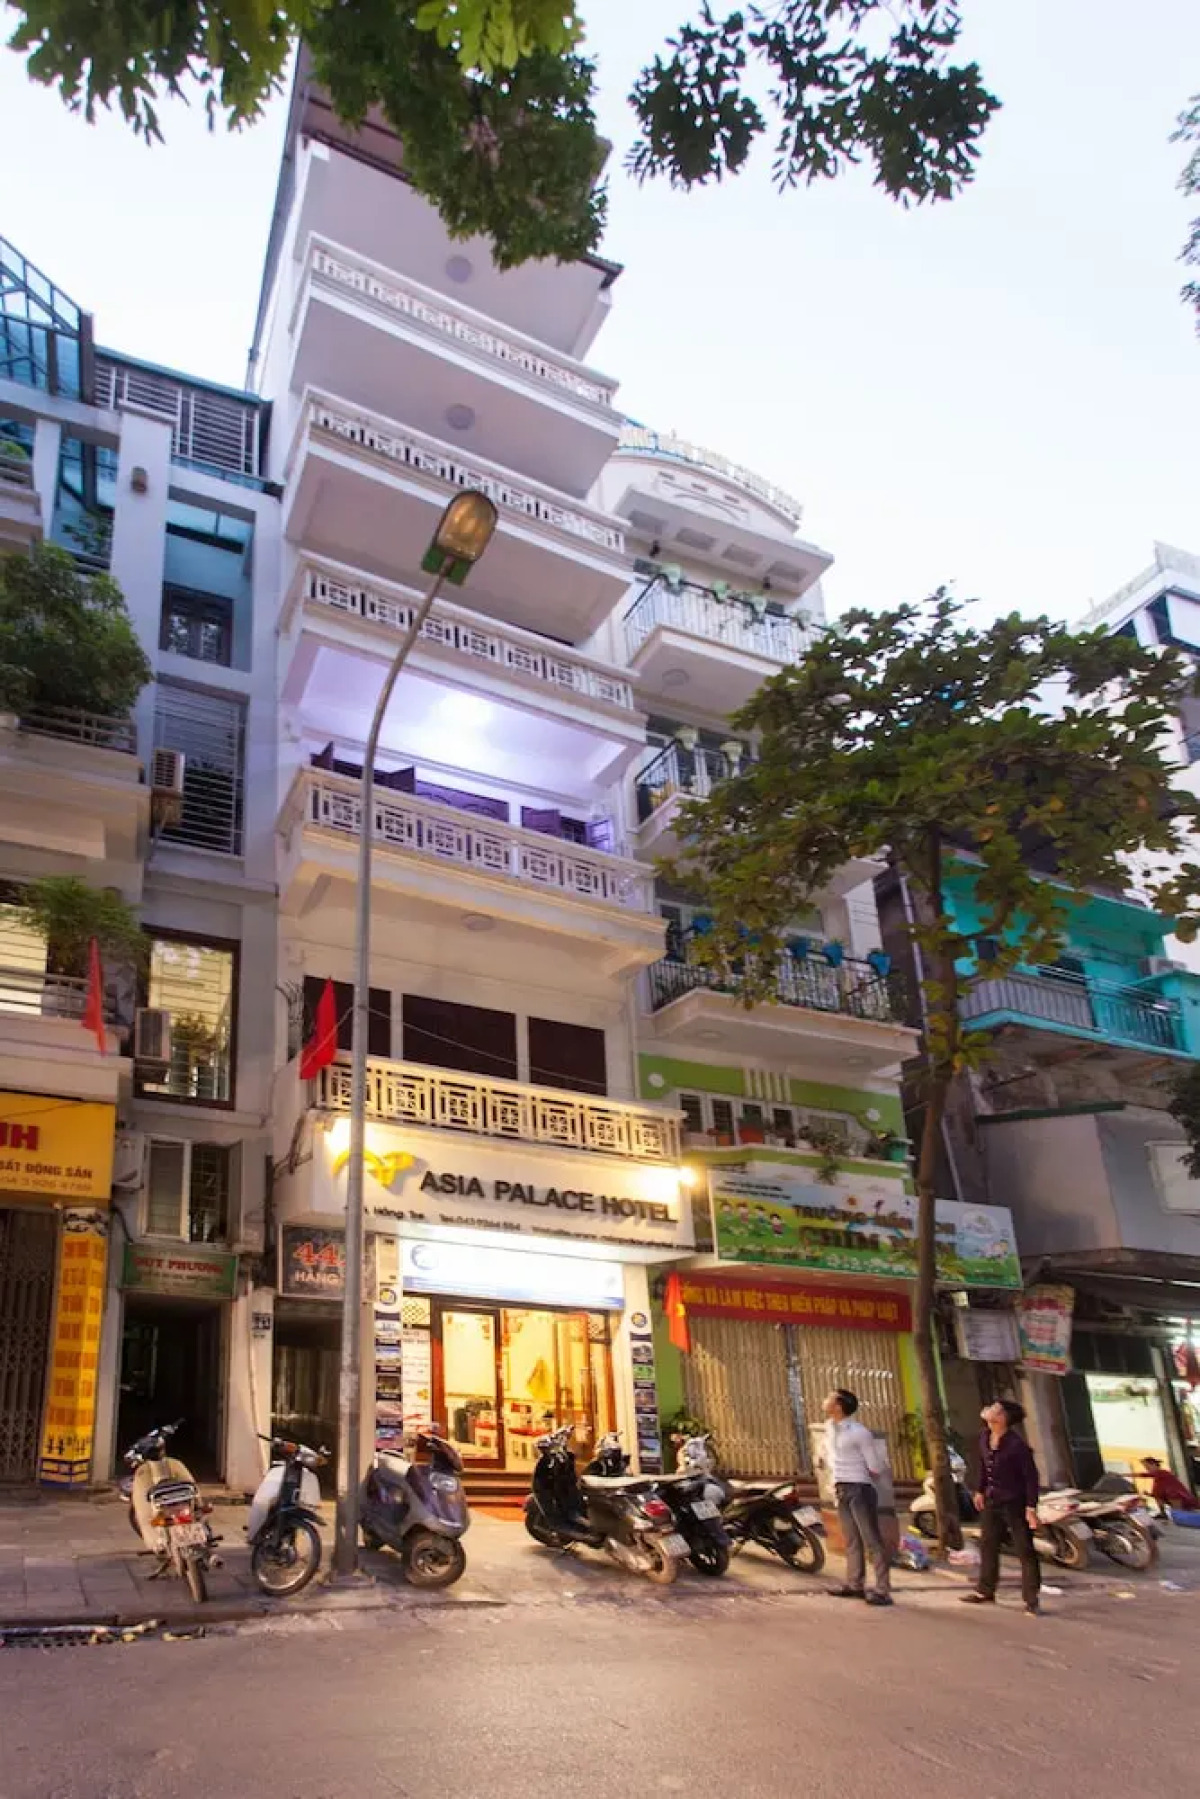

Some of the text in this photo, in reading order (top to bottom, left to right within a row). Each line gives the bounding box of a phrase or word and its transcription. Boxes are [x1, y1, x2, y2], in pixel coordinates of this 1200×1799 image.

[420, 1170, 678, 1224] ASIA PALACE HOTEL
